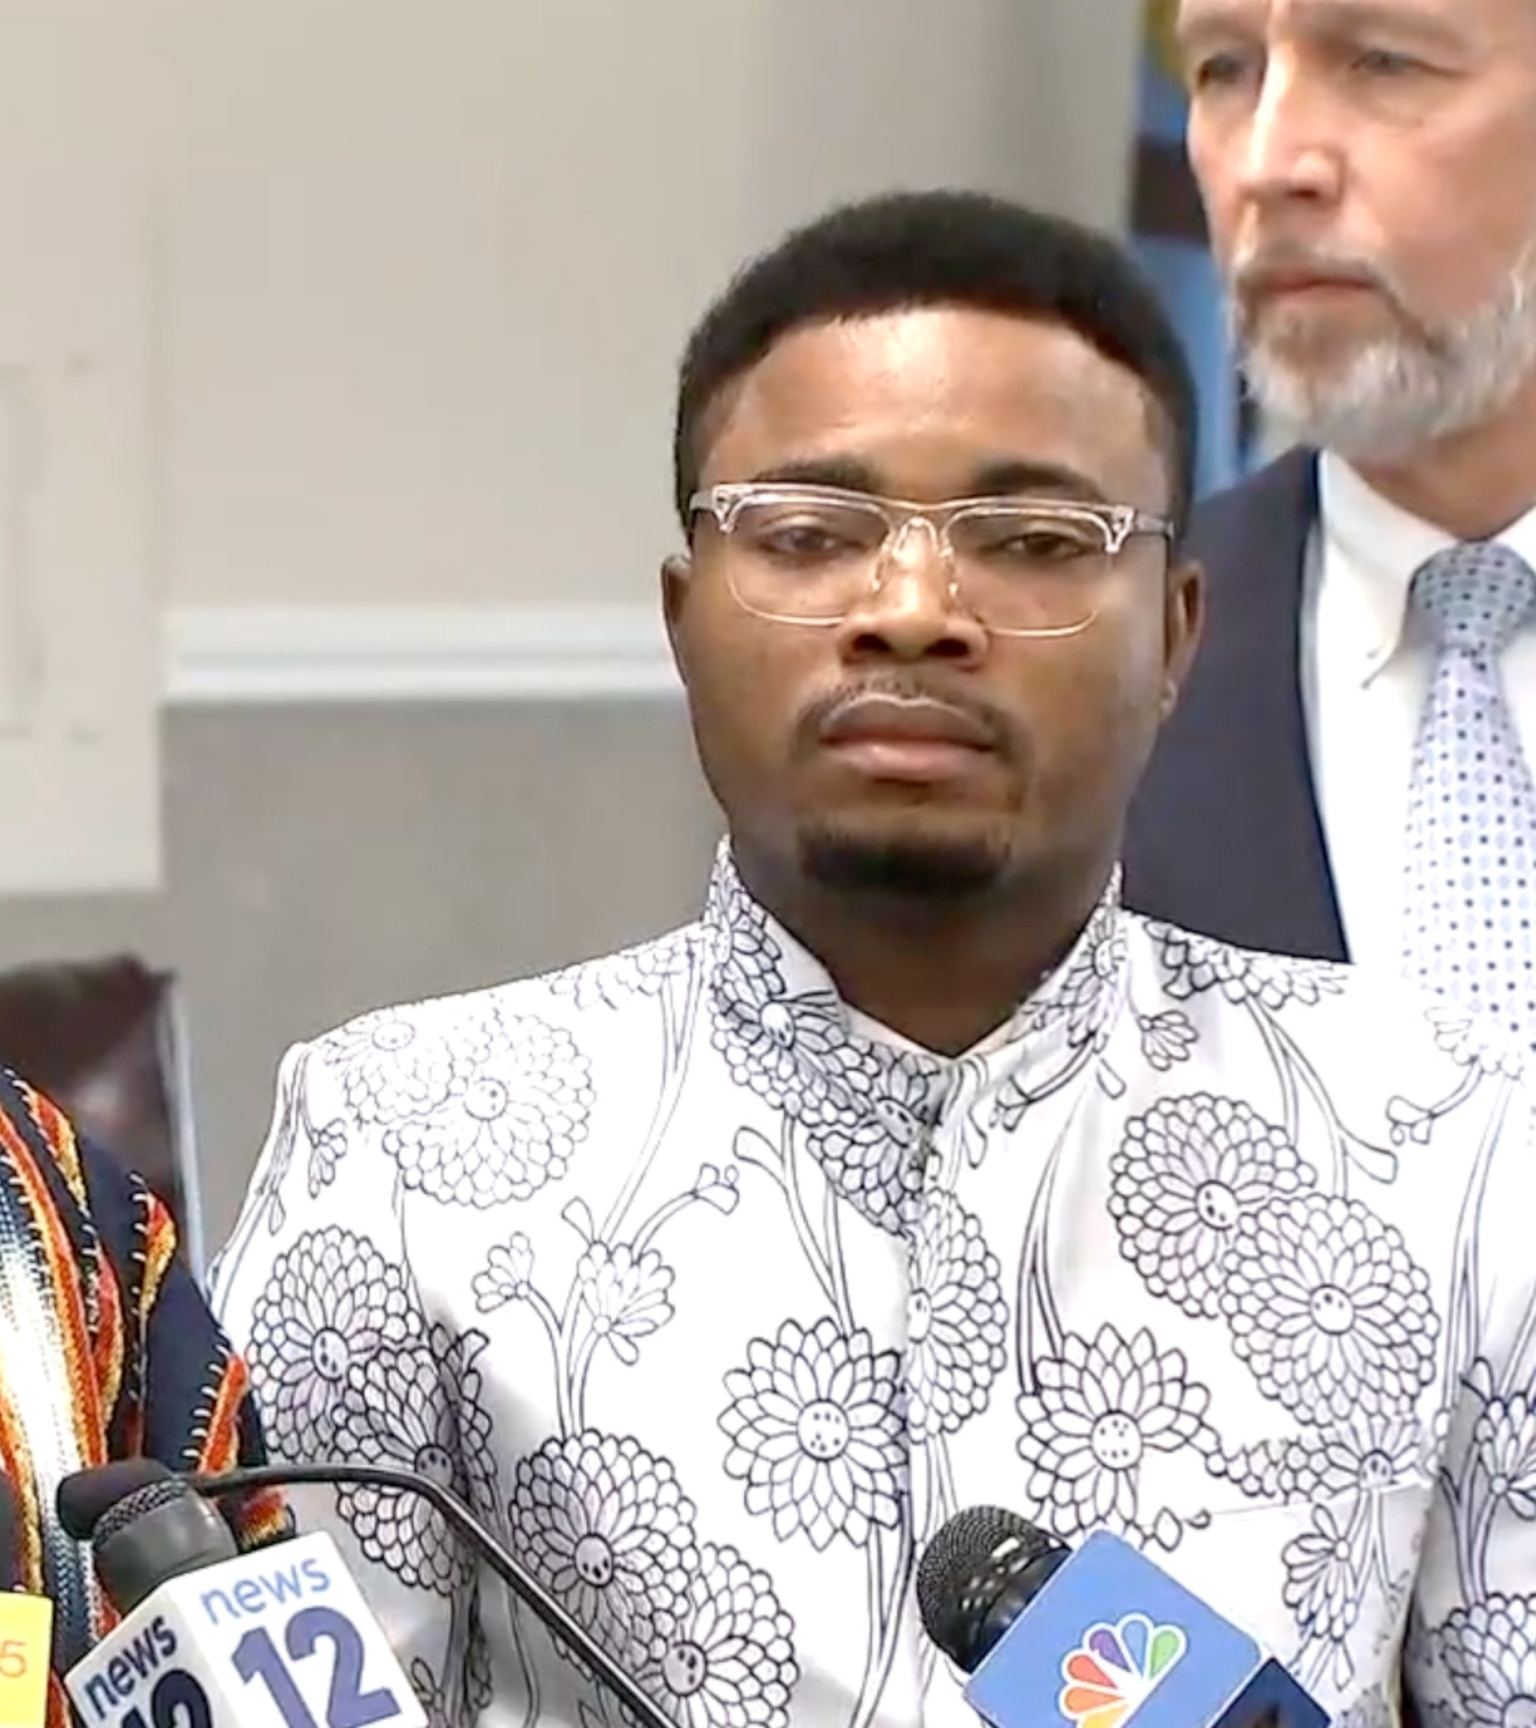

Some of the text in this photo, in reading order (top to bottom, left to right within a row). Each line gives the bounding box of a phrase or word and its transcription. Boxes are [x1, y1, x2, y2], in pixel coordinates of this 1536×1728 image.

[199, 1558, 331, 1624] news
[84, 1615, 177, 1720] news
[231, 1605, 402, 1728] 12
